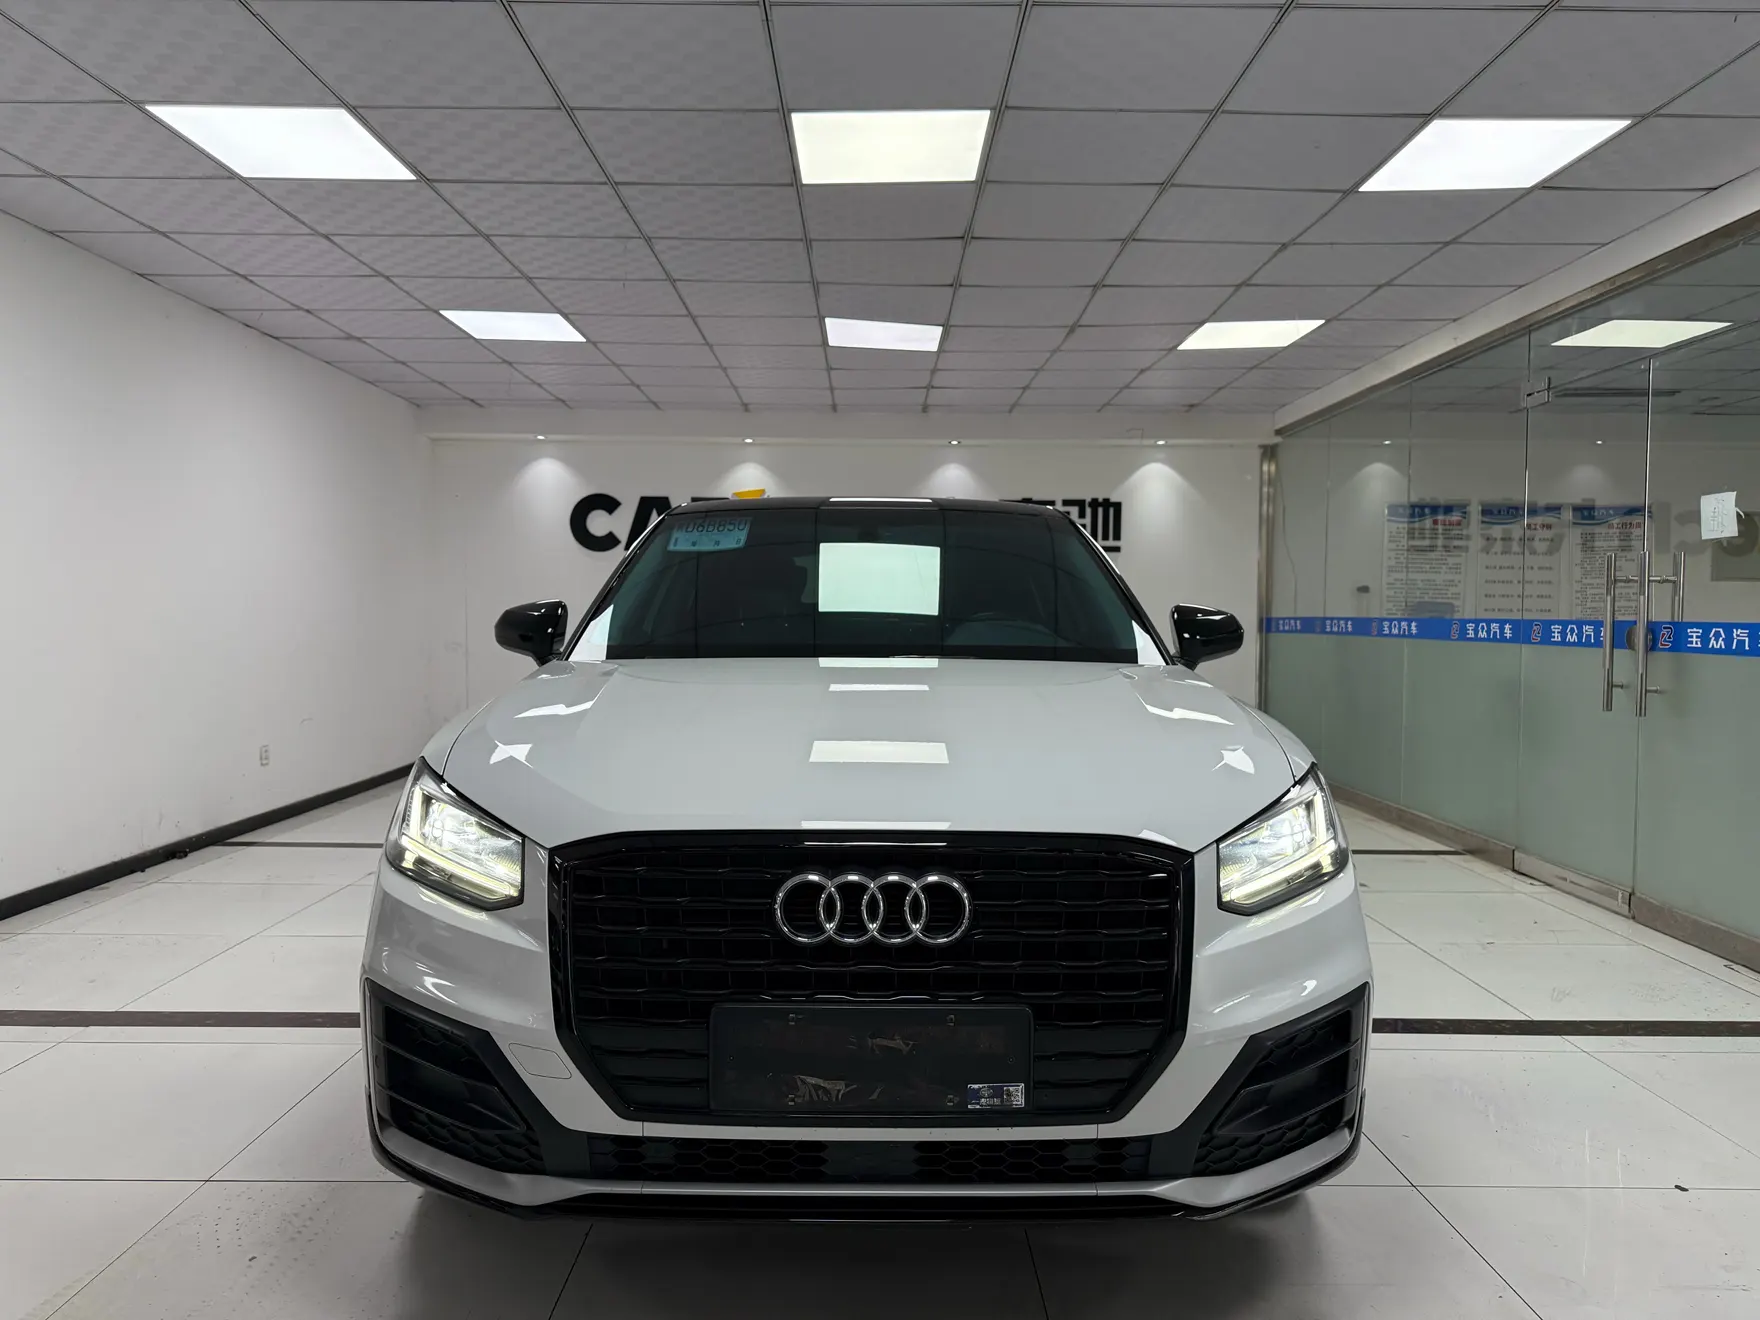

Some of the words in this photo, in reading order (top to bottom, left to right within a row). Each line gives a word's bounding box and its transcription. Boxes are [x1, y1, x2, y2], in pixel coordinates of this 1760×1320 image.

[1324, 619, 1353, 632] 宝众汽车
[1381, 621, 1419, 635] 宝众汽车
[1466, 622, 1513, 640] 宝众汽车
[1687, 627, 1760, 651] 宝众汽
